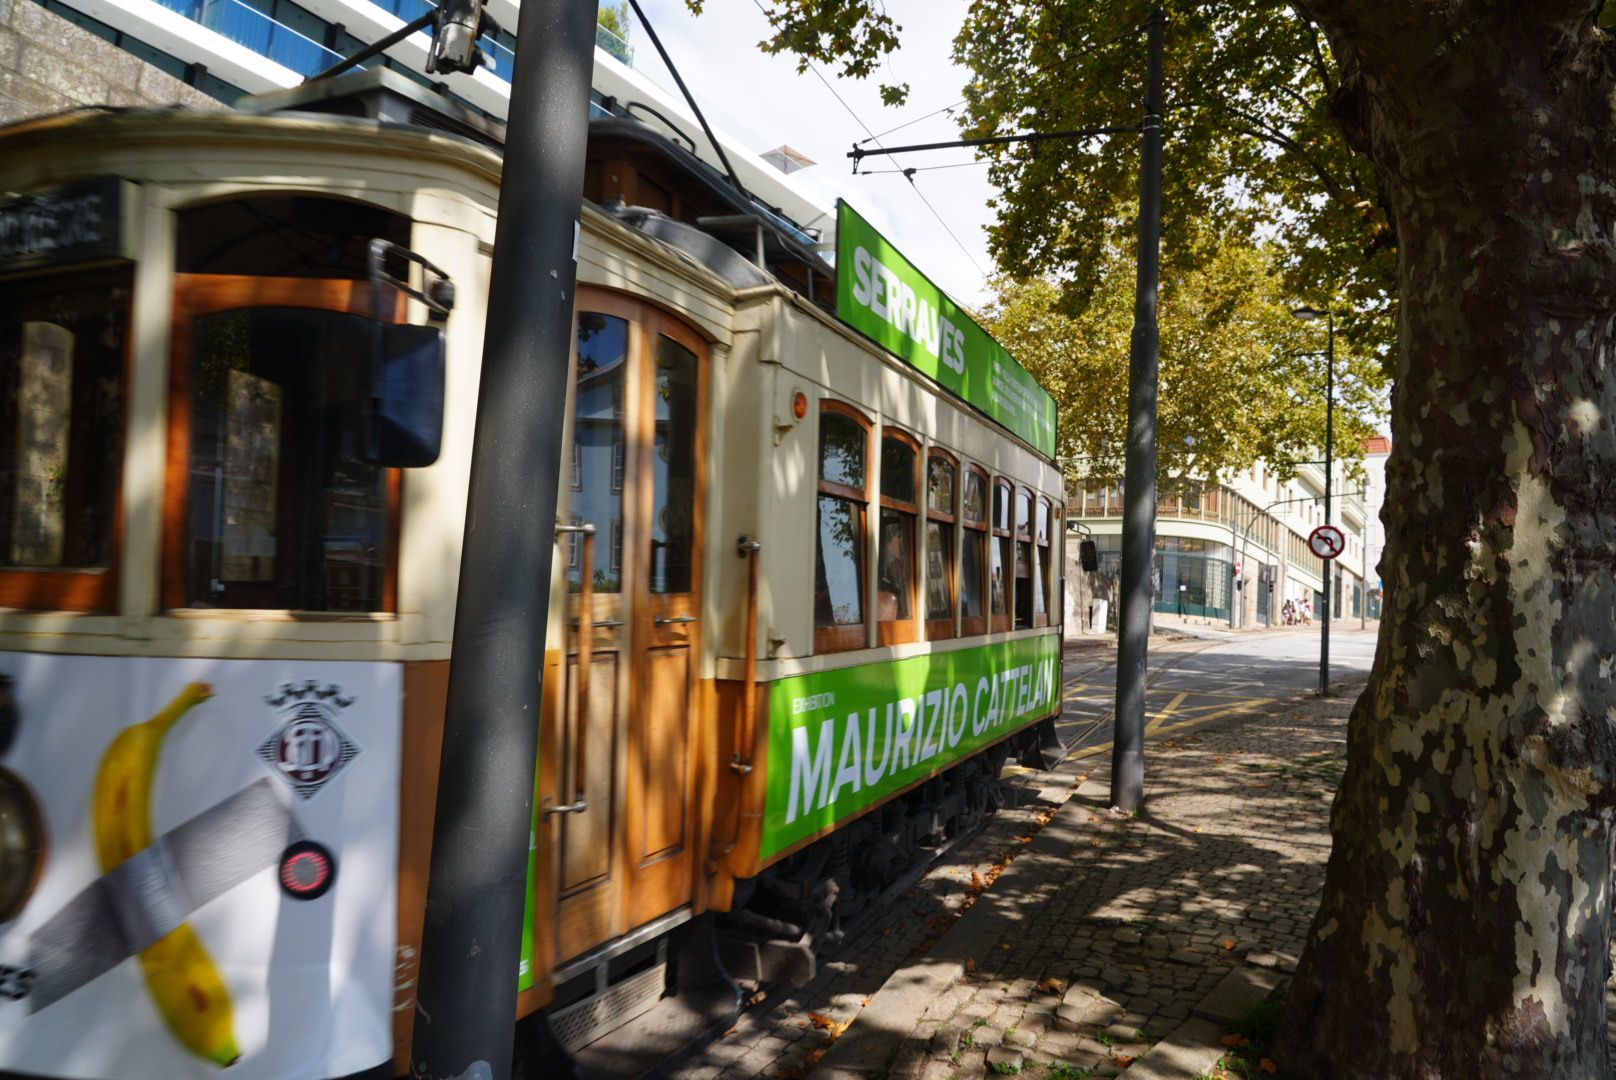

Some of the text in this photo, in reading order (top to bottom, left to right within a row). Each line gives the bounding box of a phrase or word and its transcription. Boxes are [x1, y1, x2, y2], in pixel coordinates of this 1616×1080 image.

[853, 246, 965, 375] SERRAVES
[785, 659, 1054, 825] MAURIZIO CATTELAN
